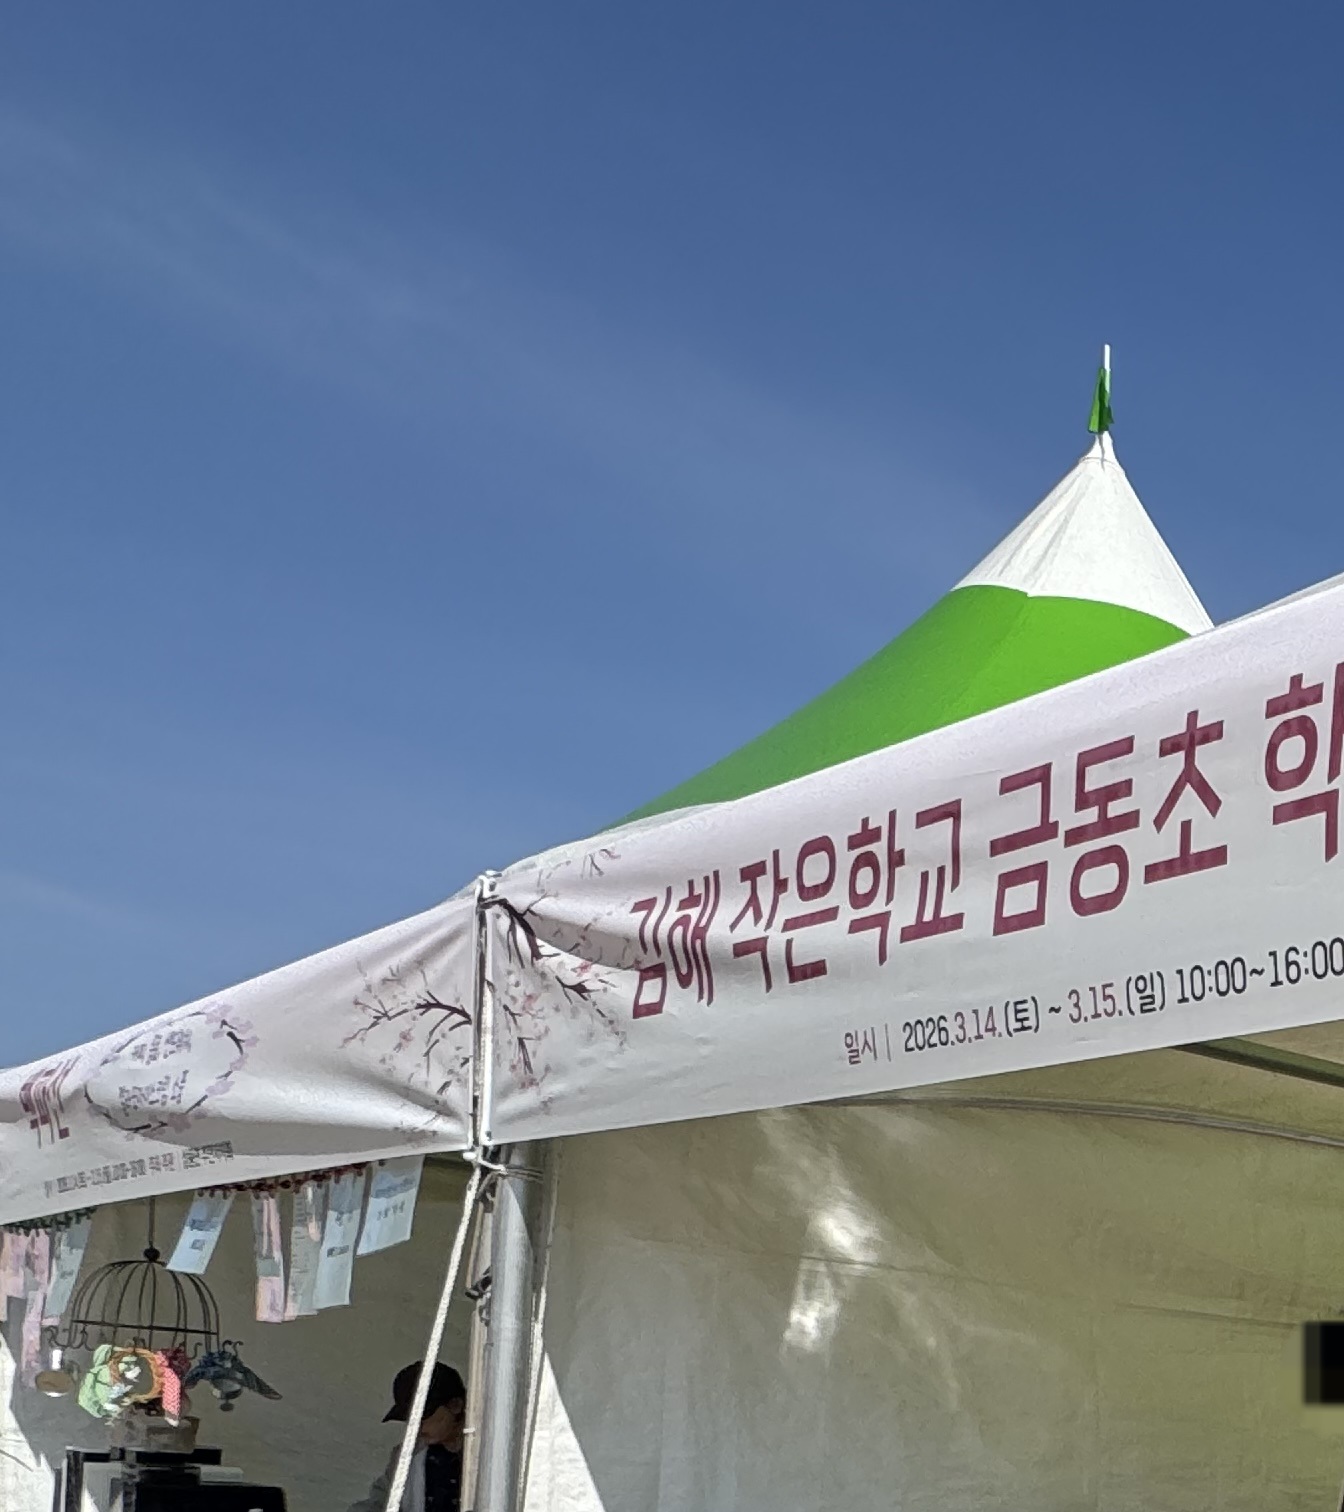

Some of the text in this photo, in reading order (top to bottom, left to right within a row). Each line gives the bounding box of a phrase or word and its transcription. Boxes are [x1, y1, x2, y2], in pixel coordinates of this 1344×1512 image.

[631, 868, 720, 1019] 김해
[729, 799, 965, 994] 작은학교
[990, 710, 1228, 936] 금동초
[844, 1029, 877, 1066] 일시
[902, 996, 1041, 1052] 2026.3.14.(토)
[1067, 970, 1167, 1025] 3.15.(일)
